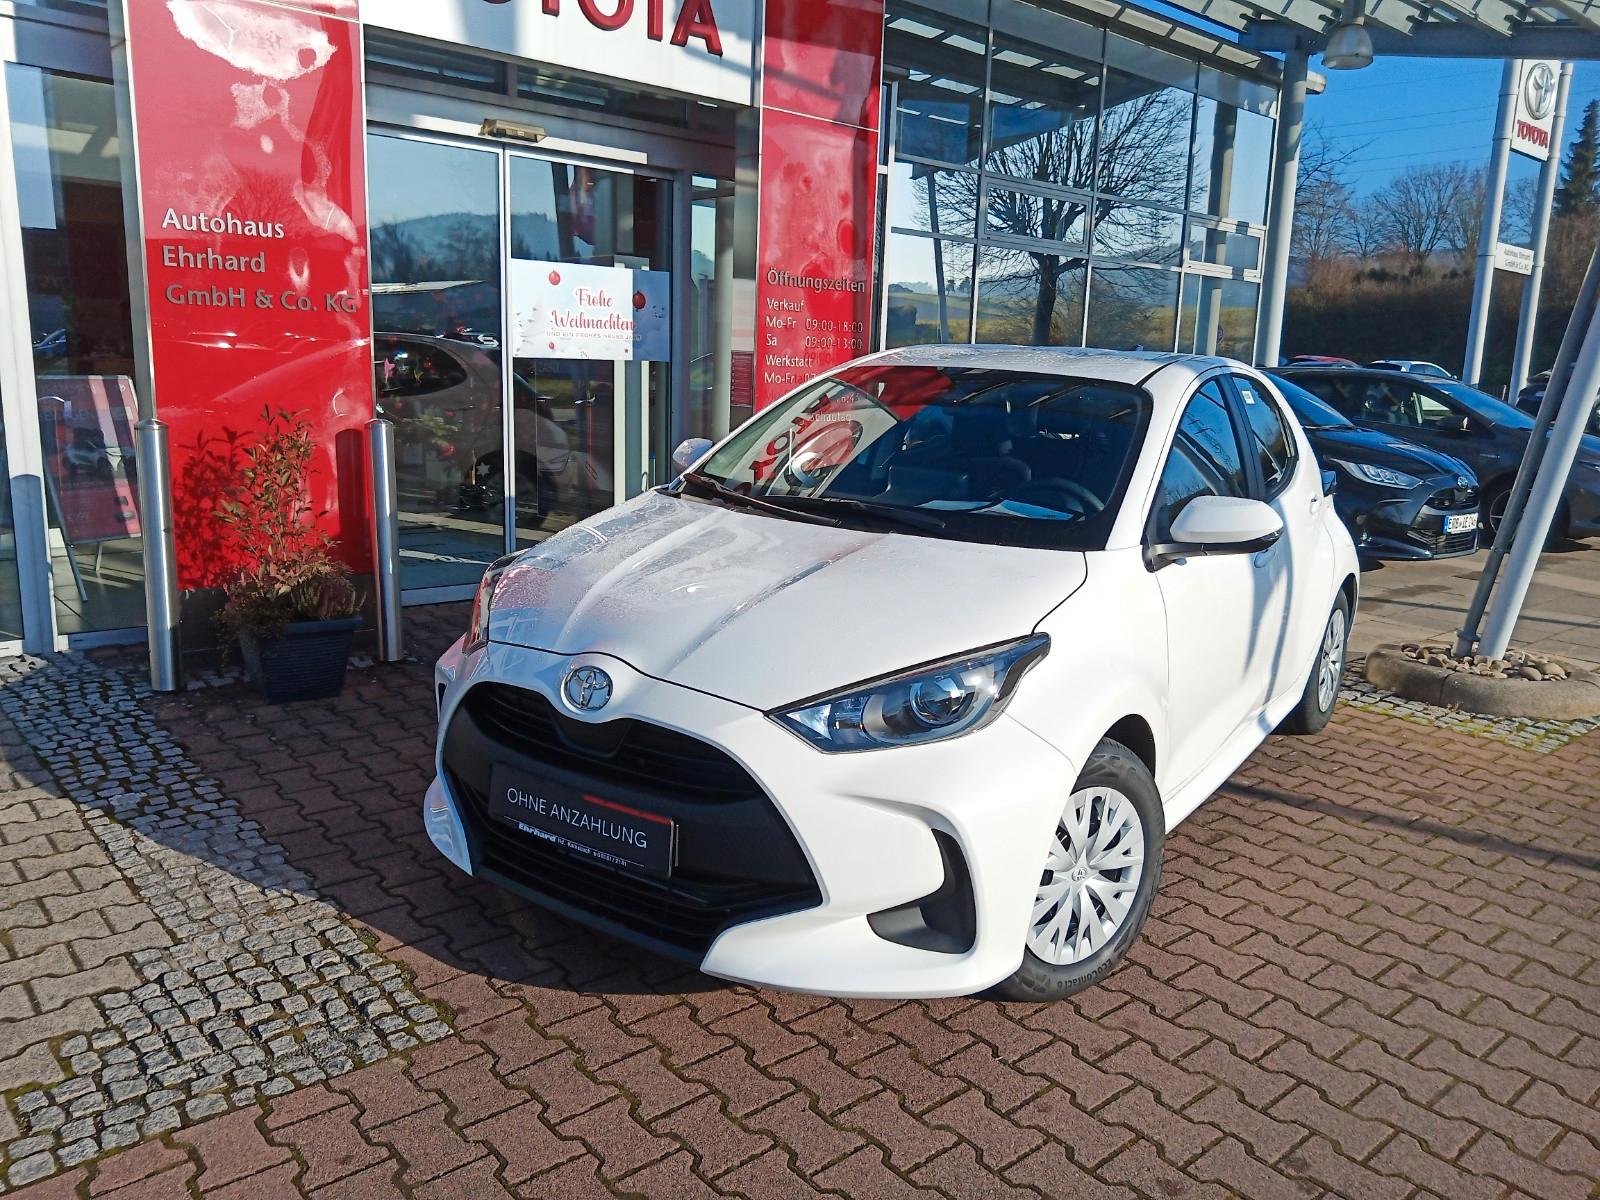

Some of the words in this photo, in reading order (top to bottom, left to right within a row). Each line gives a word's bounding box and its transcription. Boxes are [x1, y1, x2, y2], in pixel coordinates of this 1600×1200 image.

[1516, 119, 1549, 149] TOYOTA
[161, 207, 285, 239] Autohaus
[162, 244, 266, 273] Ehrhard
[767, 267, 865, 293] Öffnungszeiten
[165, 284, 246, 308] GmbH
[255, 289, 273, 309] &
[281, 291, 318, 312] Co.
[326, 293, 357, 313] KG
[575, 287, 613, 308] Frohe
[766, 297, 805, 312] Verkauf
[551, 309, 637, 331] Weihnachten
[765, 316, 797, 329] Mo-Fr
[766, 334, 777, 346] Sa
[765, 354, 813, 368] Werkstatt
[764, 372, 795, 384] Mo-Fr
[507, 787, 547, 815] OHNE
[550, 803, 647, 849] ANZAHLUNG
[518, 821, 556, 843] Ehrhard
